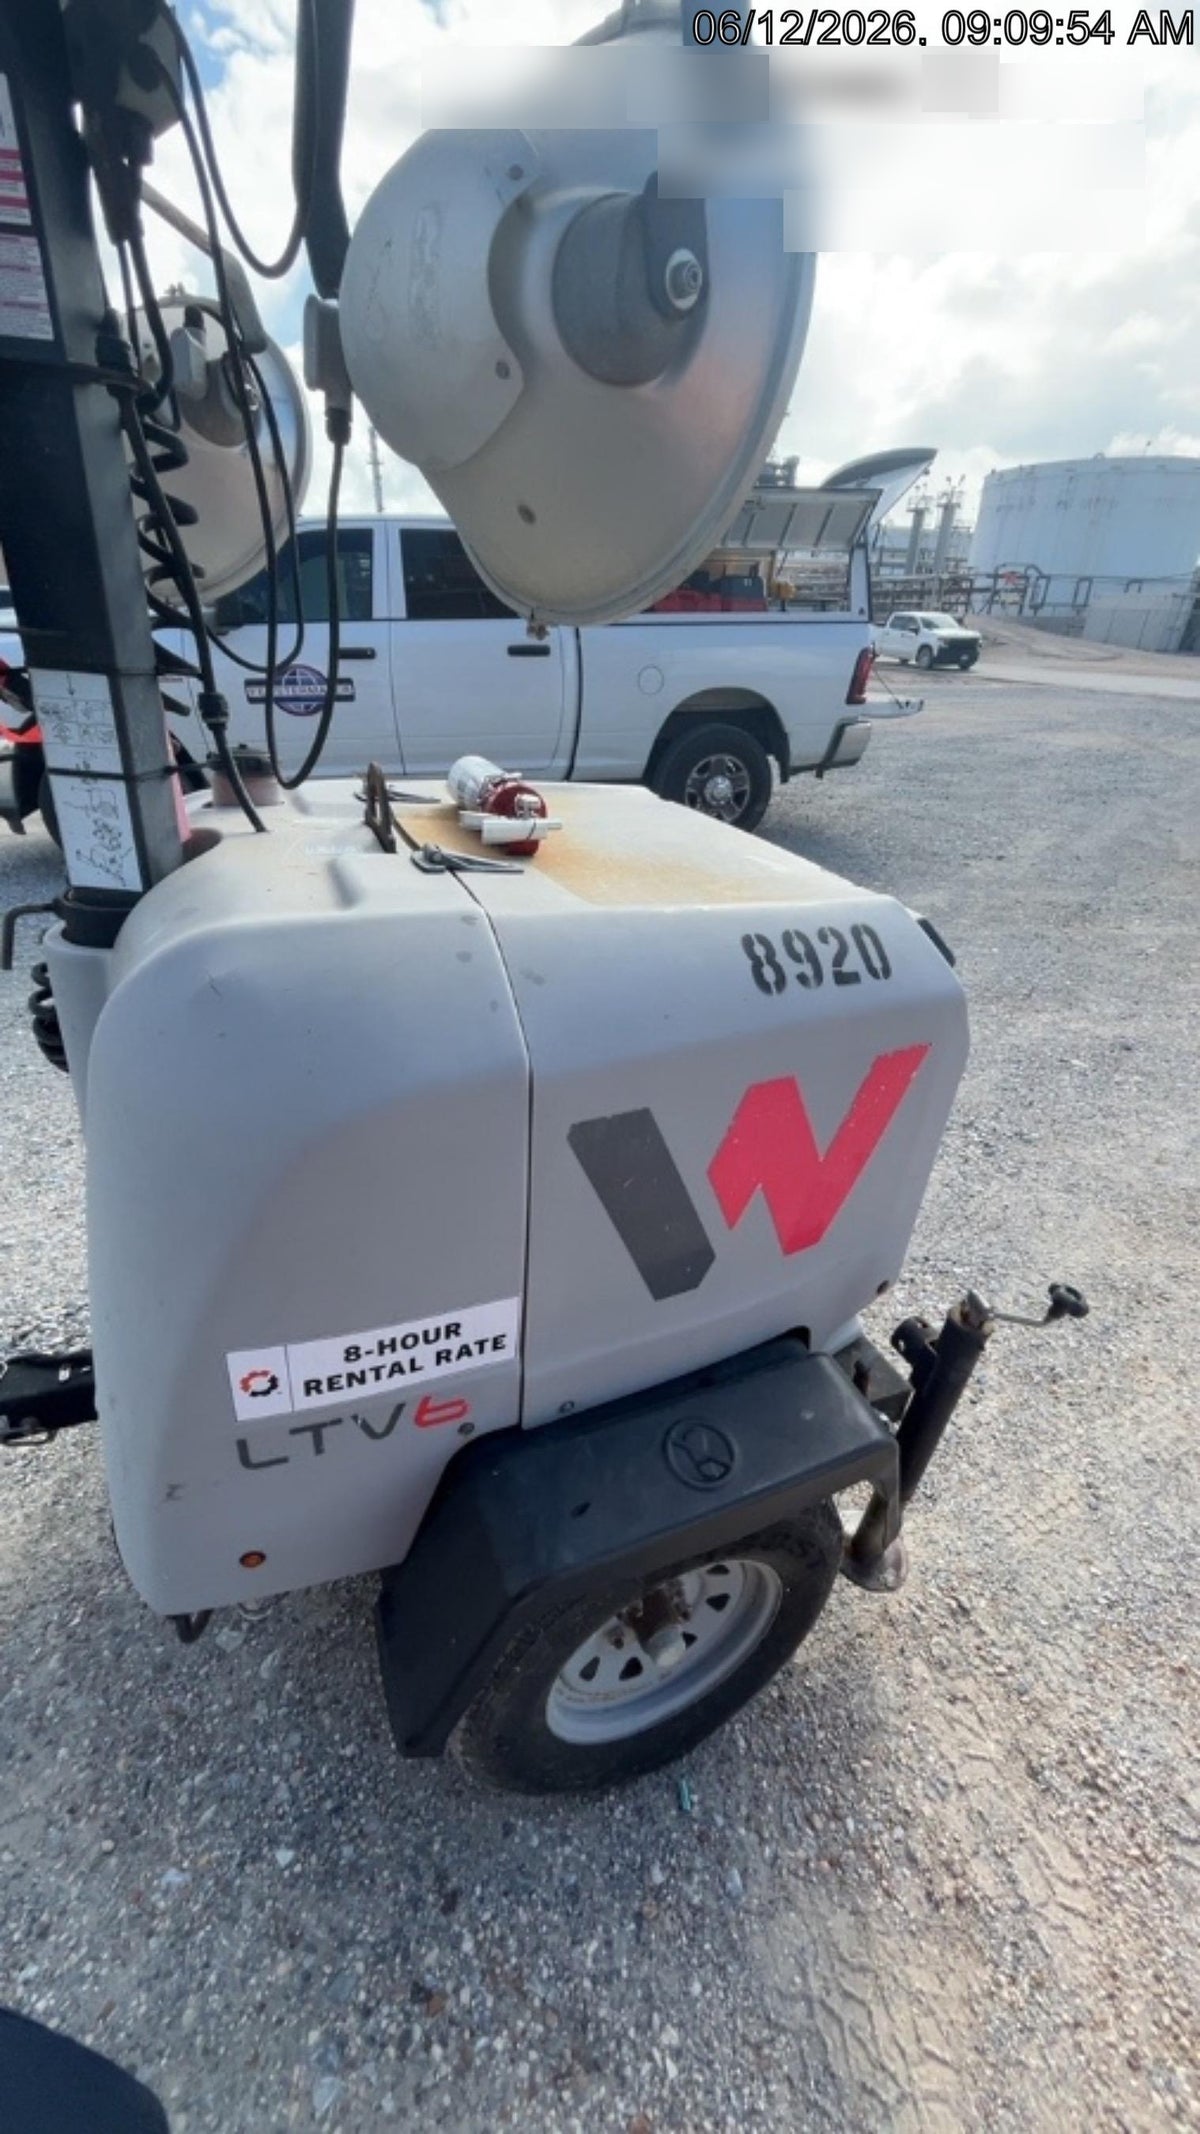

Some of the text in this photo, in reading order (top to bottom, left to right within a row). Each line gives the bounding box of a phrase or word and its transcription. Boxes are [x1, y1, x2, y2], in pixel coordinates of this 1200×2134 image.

[741, 924, 892, 996] 8920
[303, 1333, 507, 1398] RENTAL RATE
[343, 1322, 462, 1364] 8-HOUR
[235, 1395, 472, 1471] LTV6
